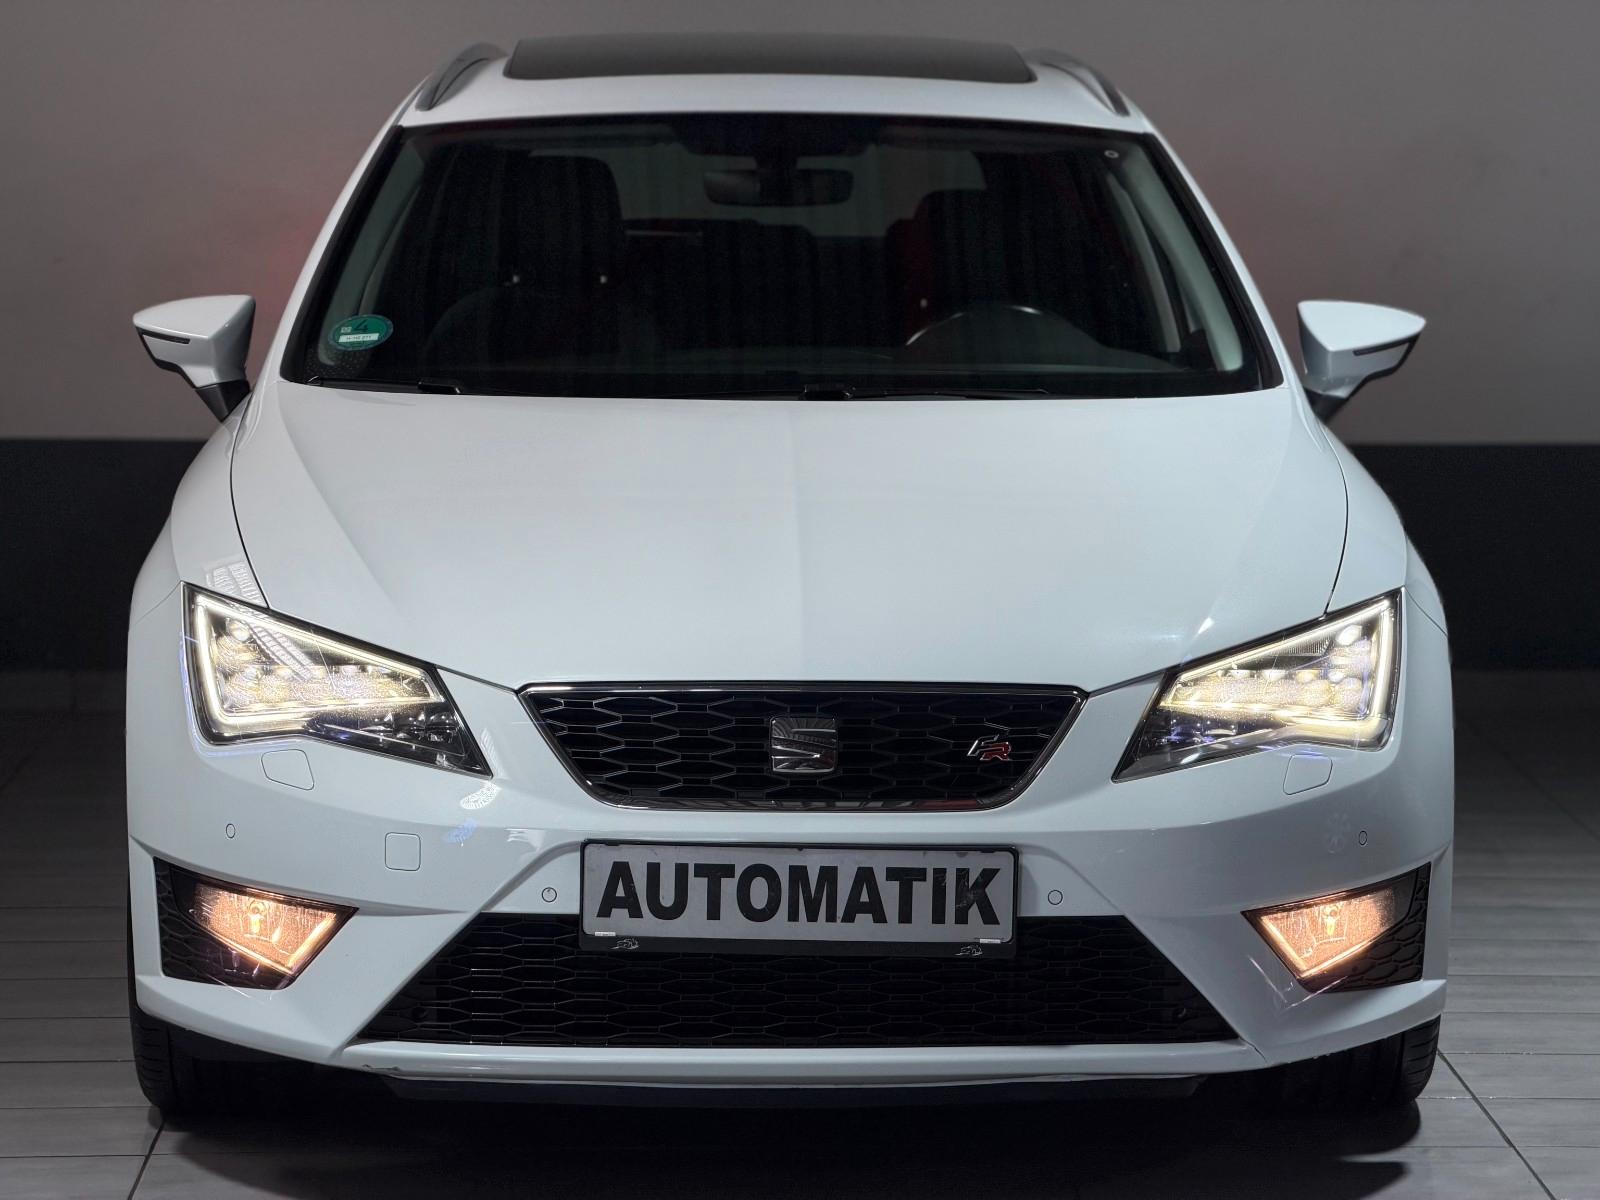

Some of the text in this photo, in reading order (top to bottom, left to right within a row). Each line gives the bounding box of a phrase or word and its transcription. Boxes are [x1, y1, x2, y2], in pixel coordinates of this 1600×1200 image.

[354, 319, 368, 332] 4
[967, 734, 1011, 761] FR
[596, 861, 1001, 925] AUTOMATIK
